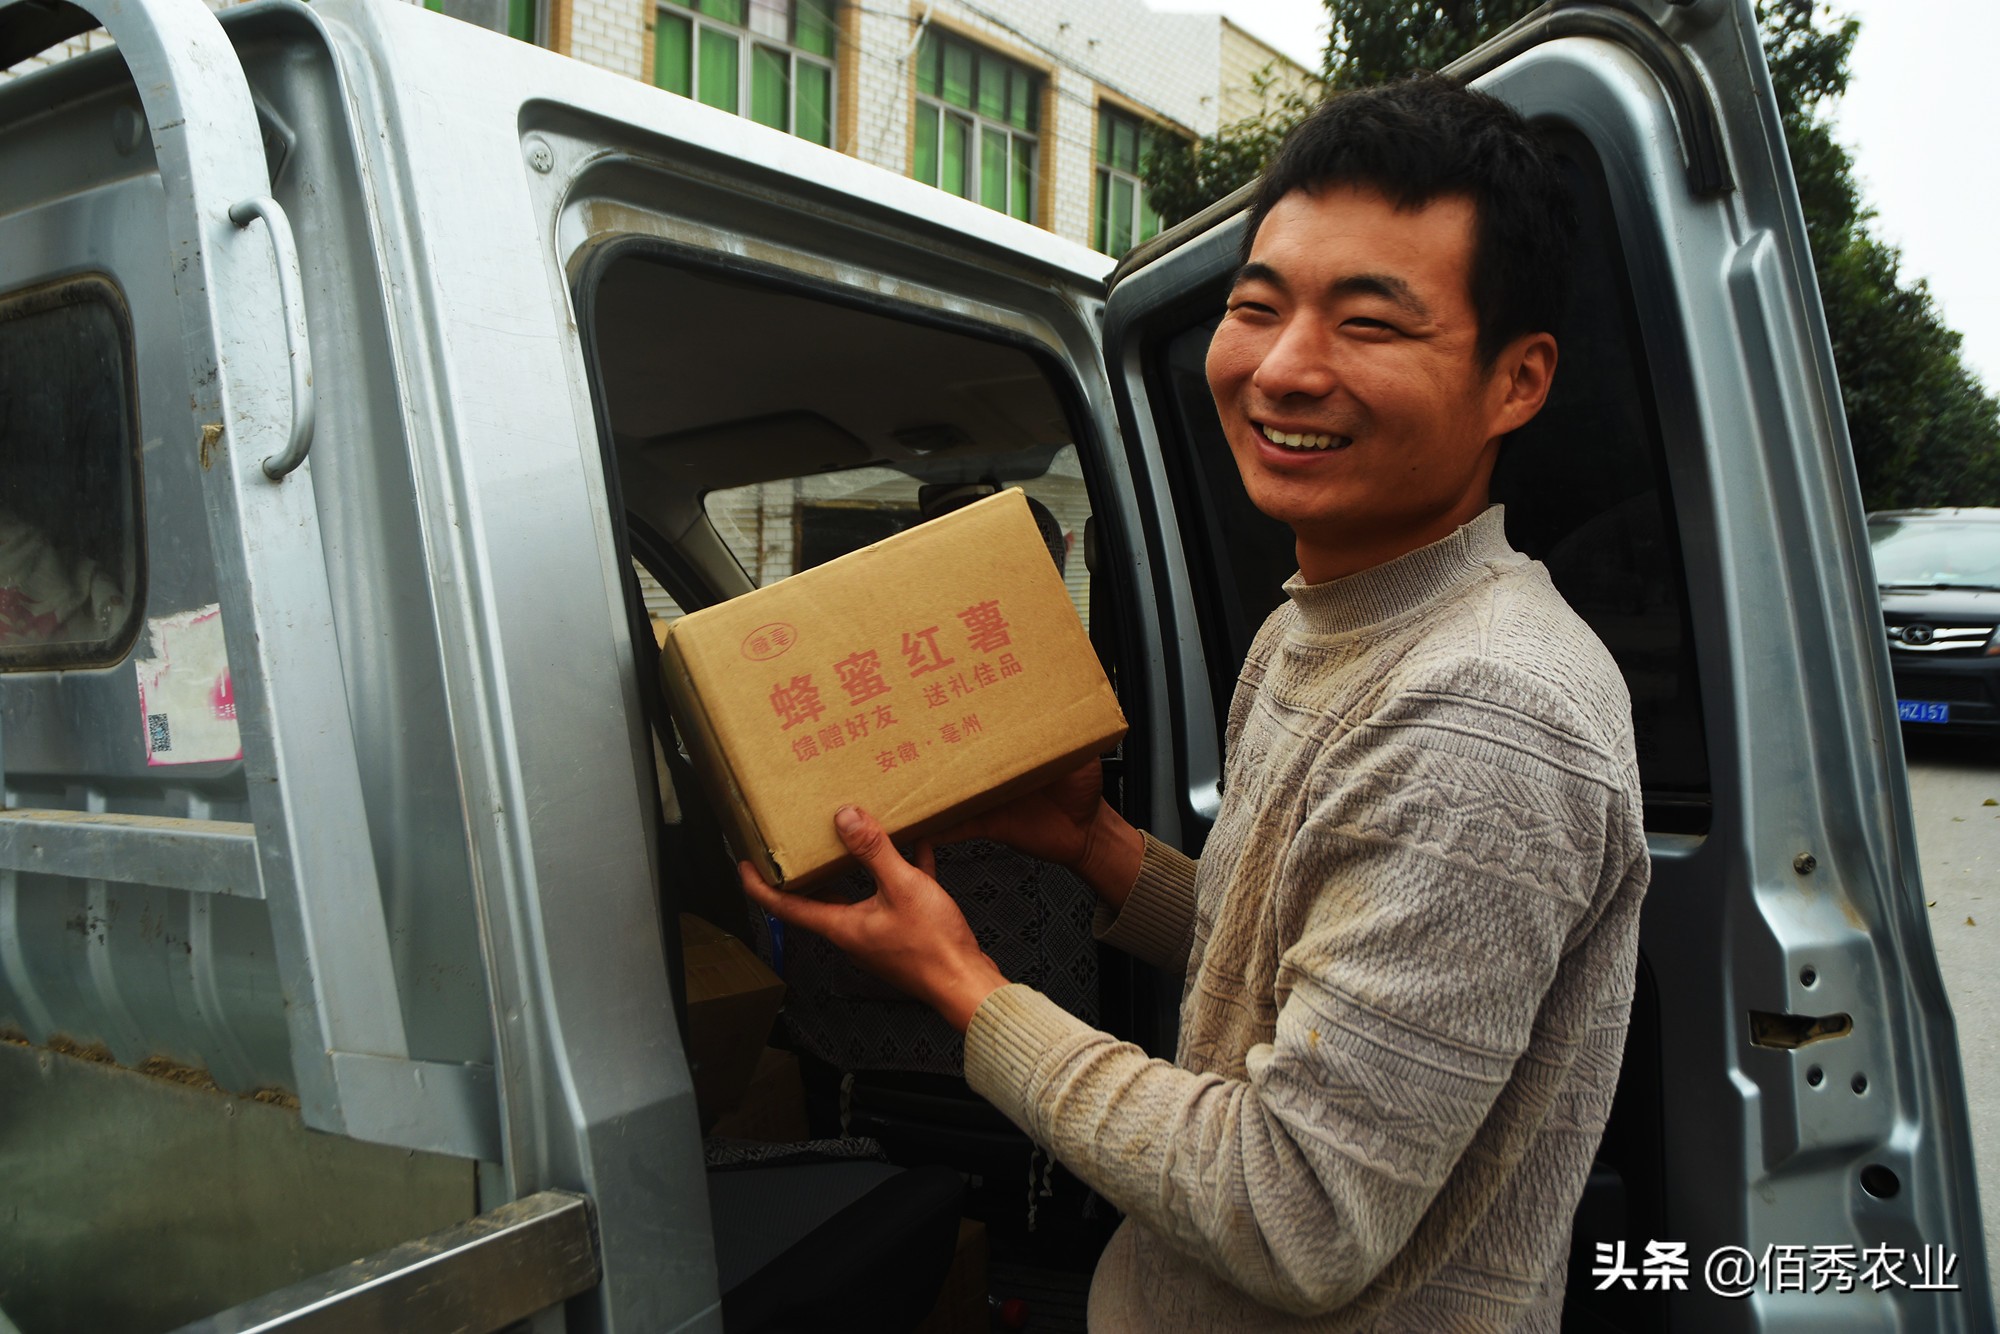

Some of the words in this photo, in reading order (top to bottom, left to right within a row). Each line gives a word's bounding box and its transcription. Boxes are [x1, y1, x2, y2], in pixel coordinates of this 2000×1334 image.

[769, 600, 1012, 731] 蜂蜜红薯
[792, 704, 899, 763] 馈赠好友
[923, 652, 1023, 709] 送礼佳品
